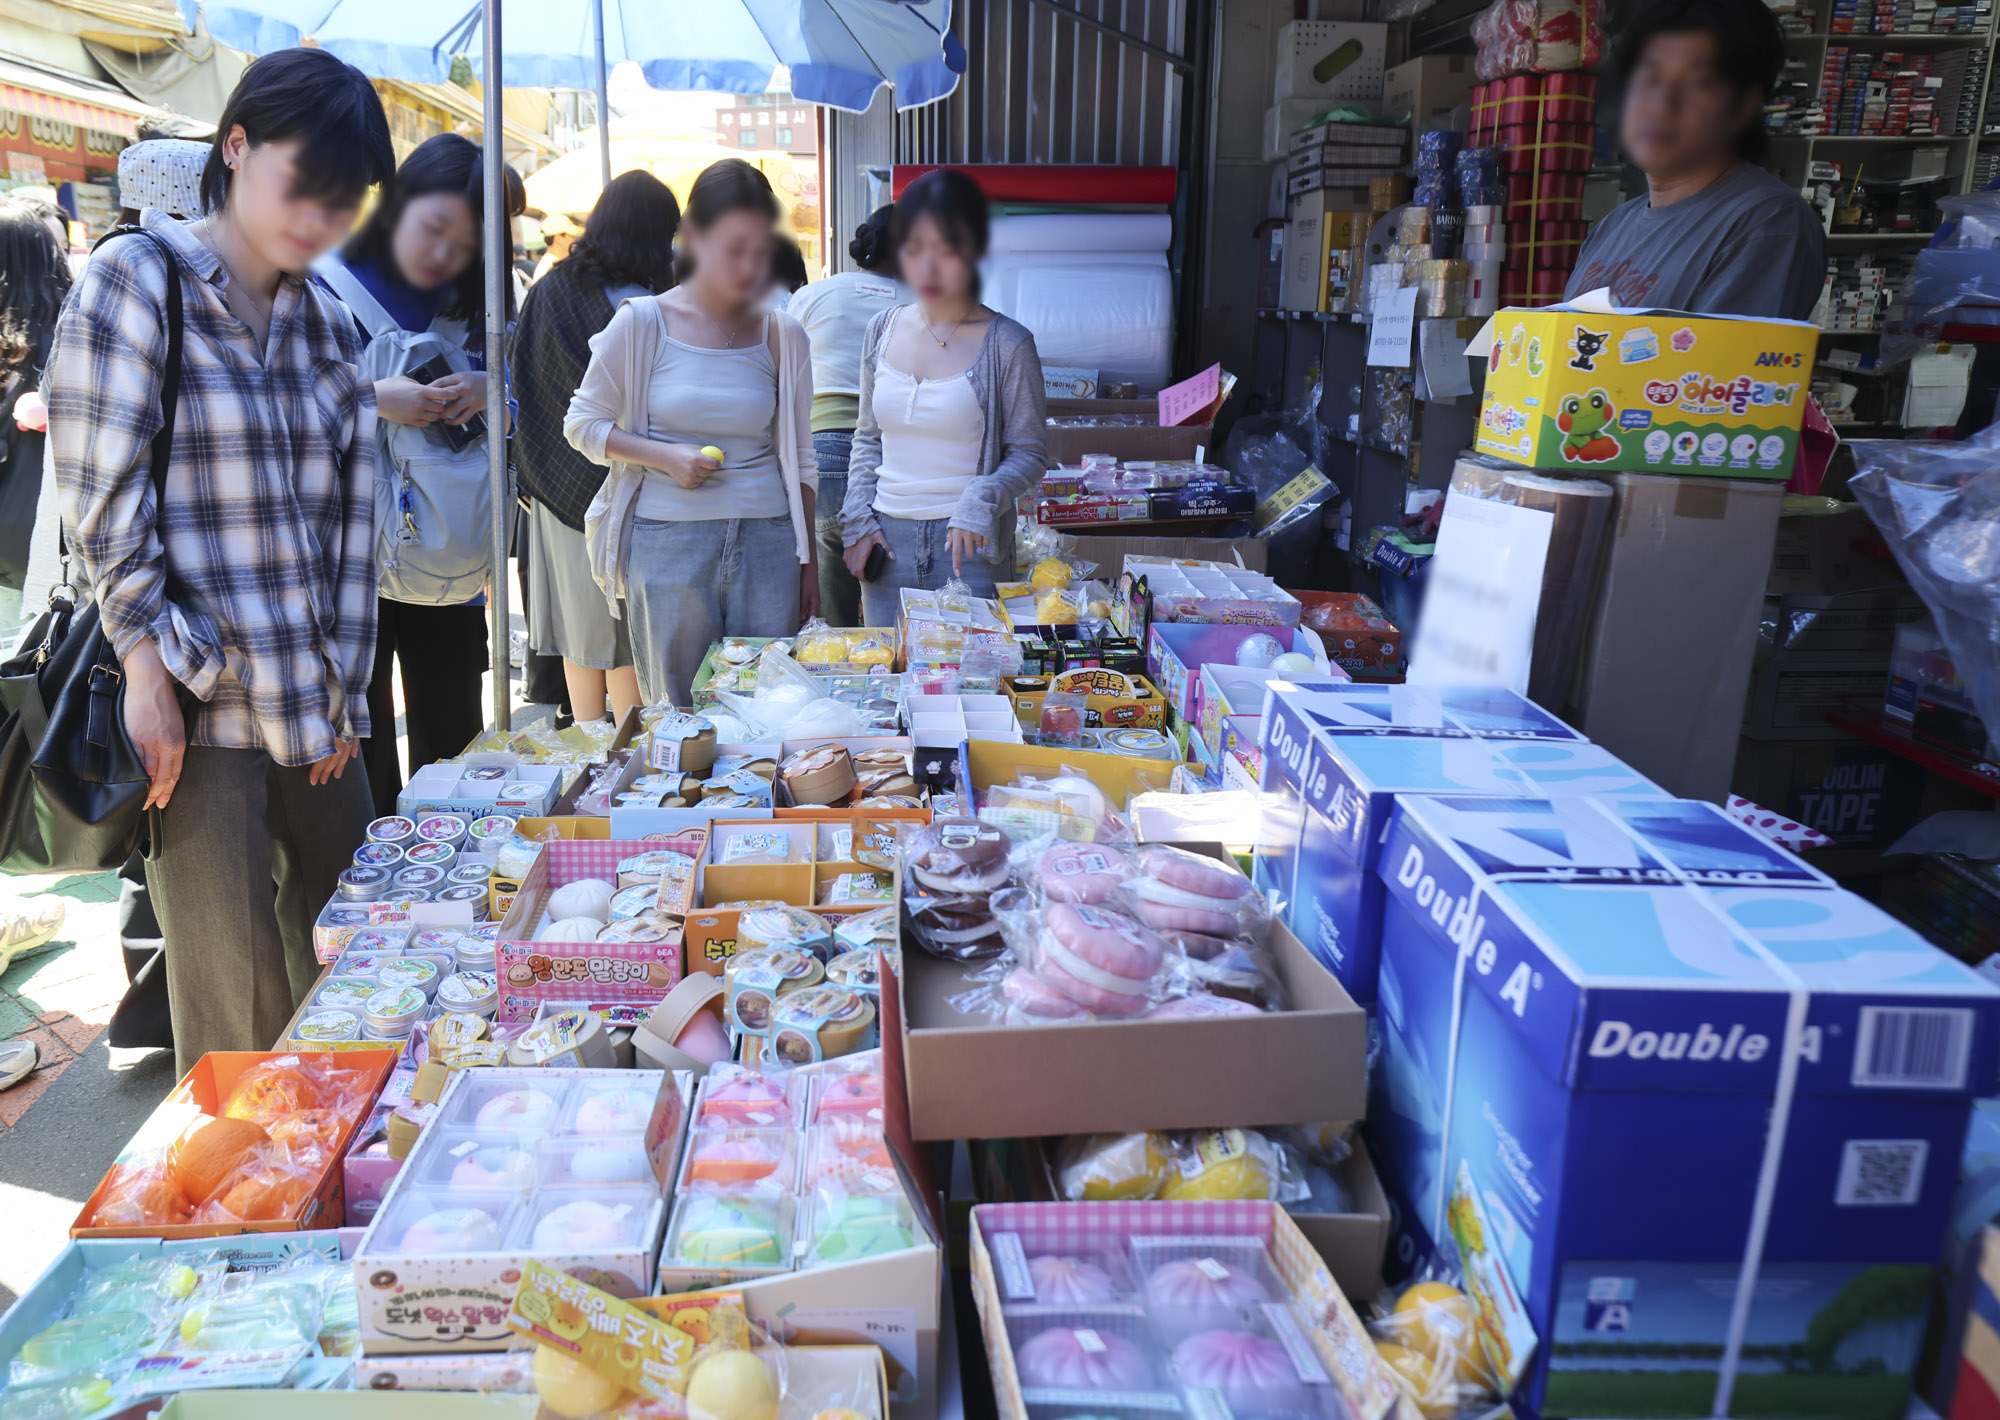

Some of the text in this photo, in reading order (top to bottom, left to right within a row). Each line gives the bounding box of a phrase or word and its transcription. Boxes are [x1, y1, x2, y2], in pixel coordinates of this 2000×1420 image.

[1682, 377, 1796, 414] 아이클레이
[1376, 544, 1399, 566] Double
[1799, 793, 1881, 832] TAPE
[528, 954, 650, 984] 왕만두 말랑이
[656, 948, 673, 957] 6EA
[1498, 960, 1532, 1018] A
[1588, 1020, 1770, 1063] Double
[461, 1305, 510, 1325] 말랑
